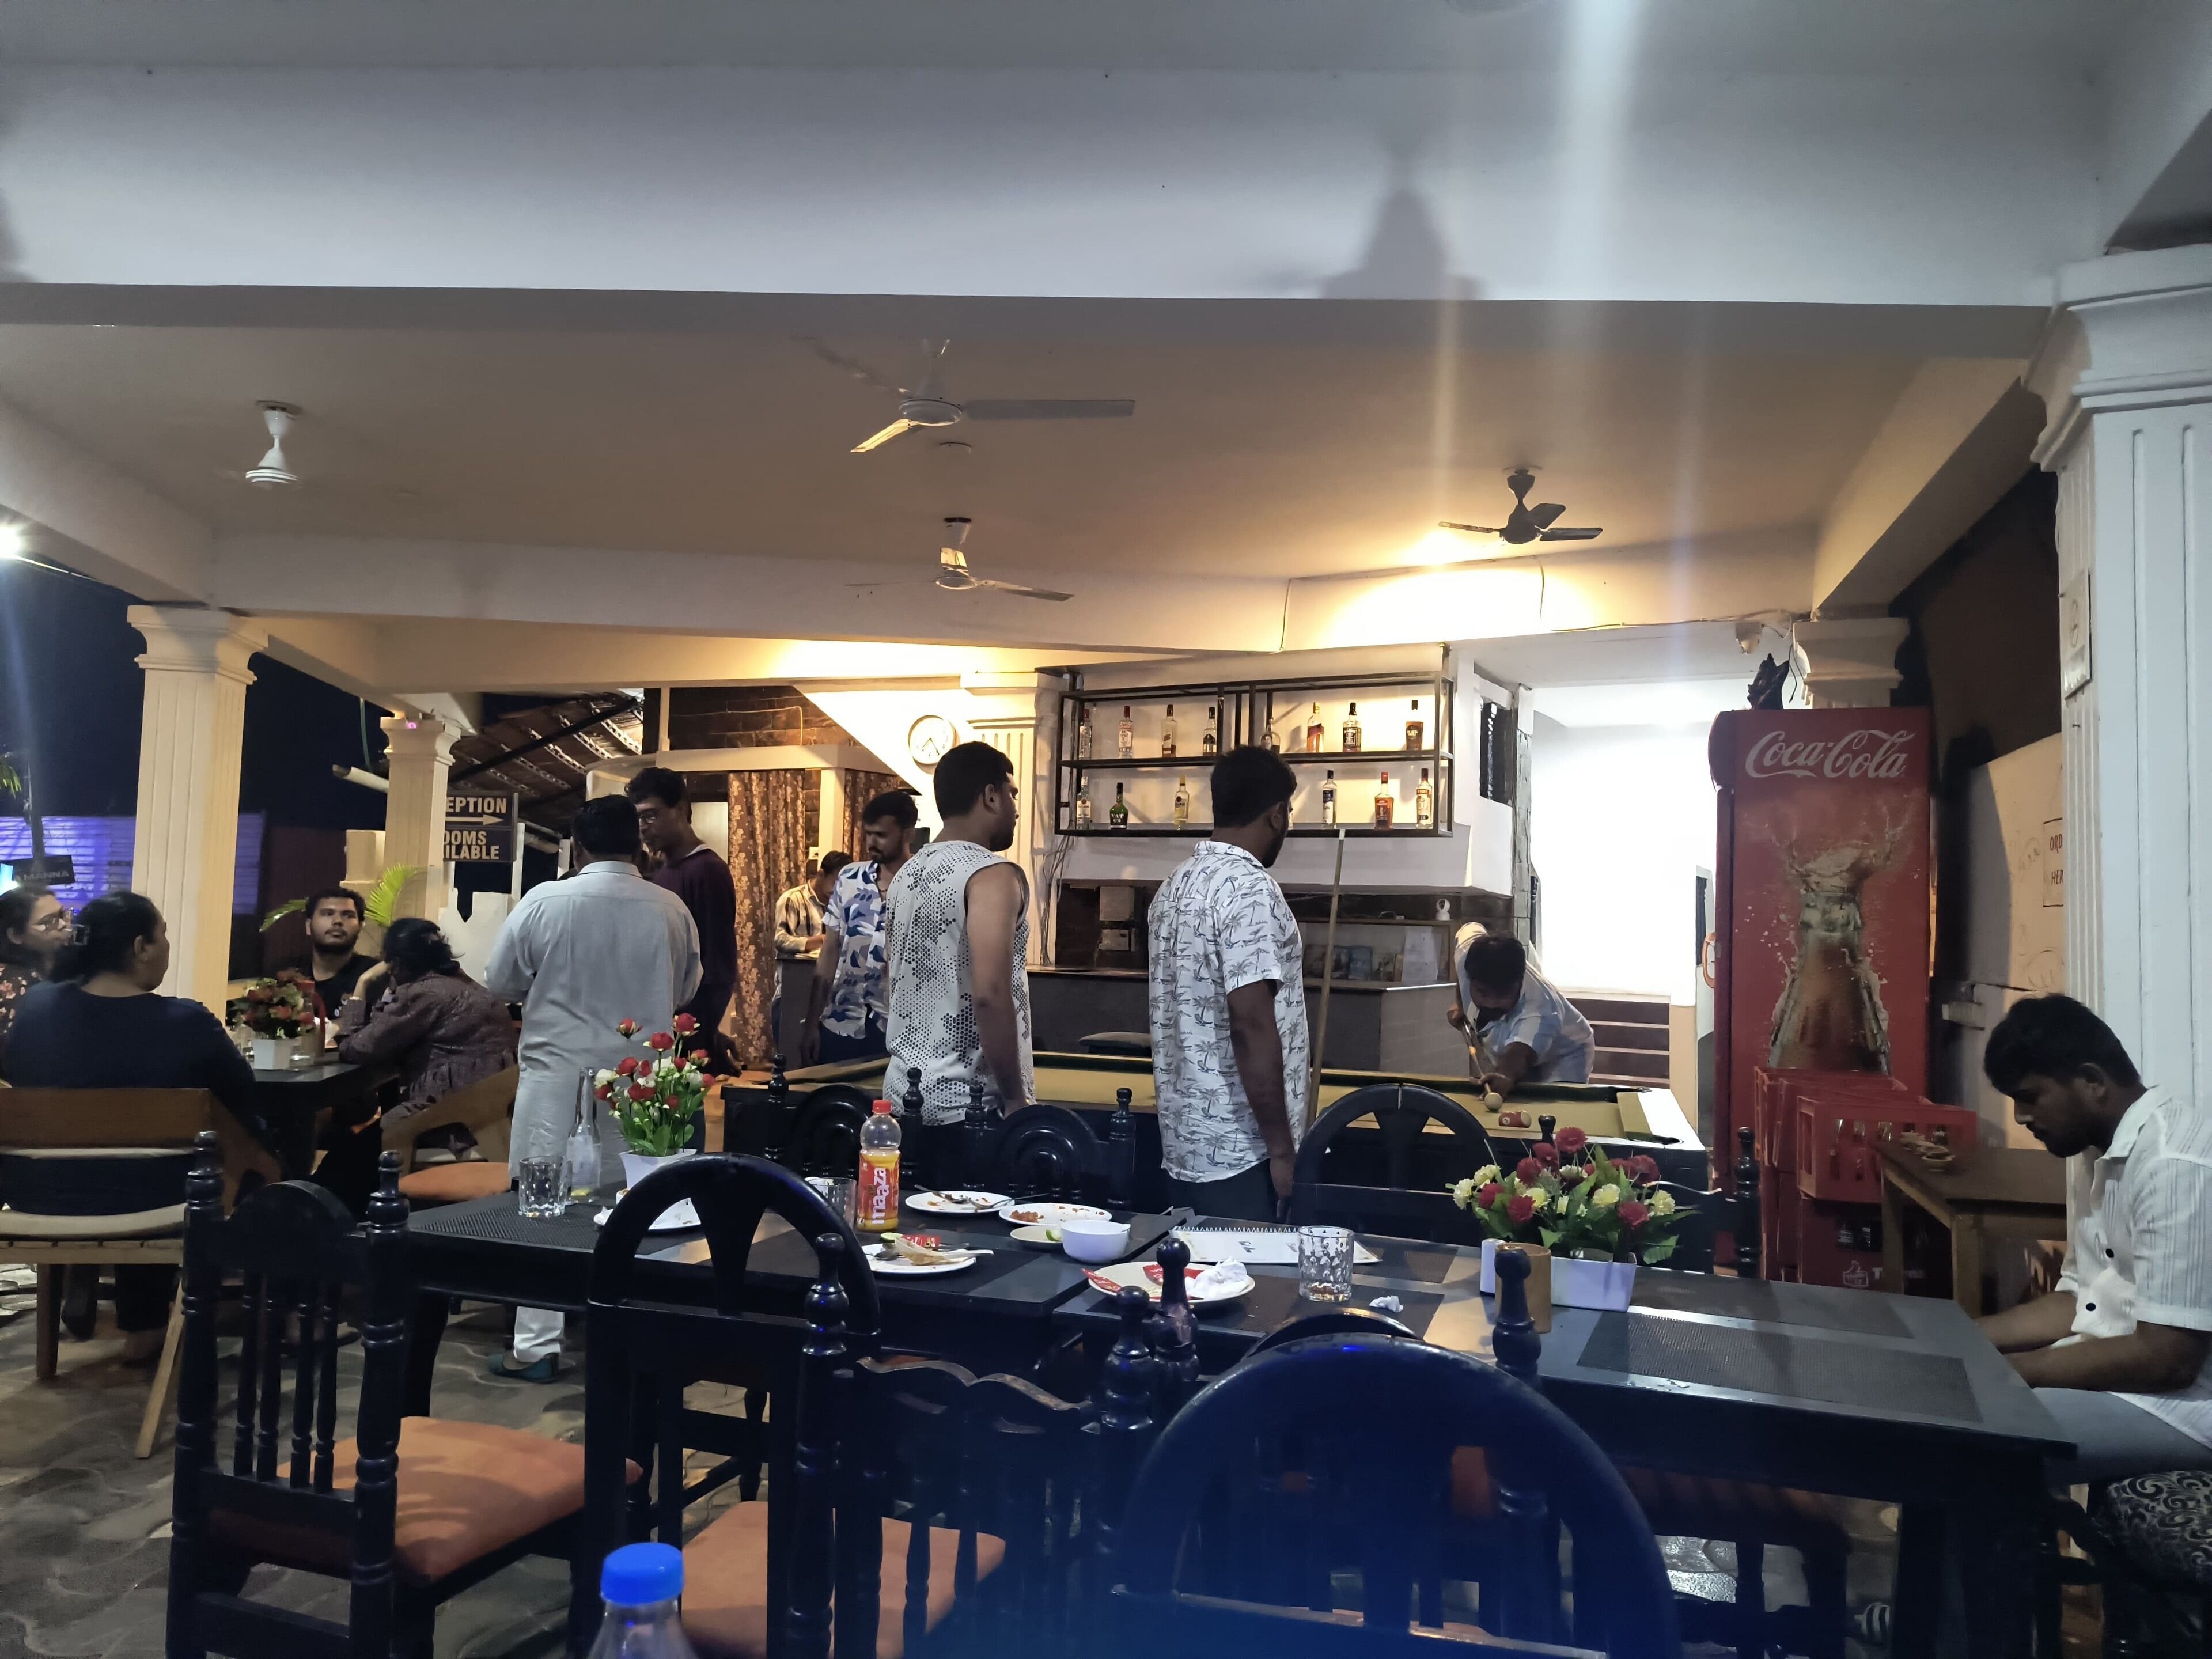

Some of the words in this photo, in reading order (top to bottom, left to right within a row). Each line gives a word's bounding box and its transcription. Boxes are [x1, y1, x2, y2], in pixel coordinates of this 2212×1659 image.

[1745, 729, 1915, 778] Coca-Cola
[446, 797, 507, 813] EPTION
[444, 830, 487, 845] OOMS
[2050, 834, 2063, 854] ORD
[445, 844, 499, 859] ILABLE
[2051, 869, 2063, 885] HER
[872, 1167, 889, 1224] maaza
